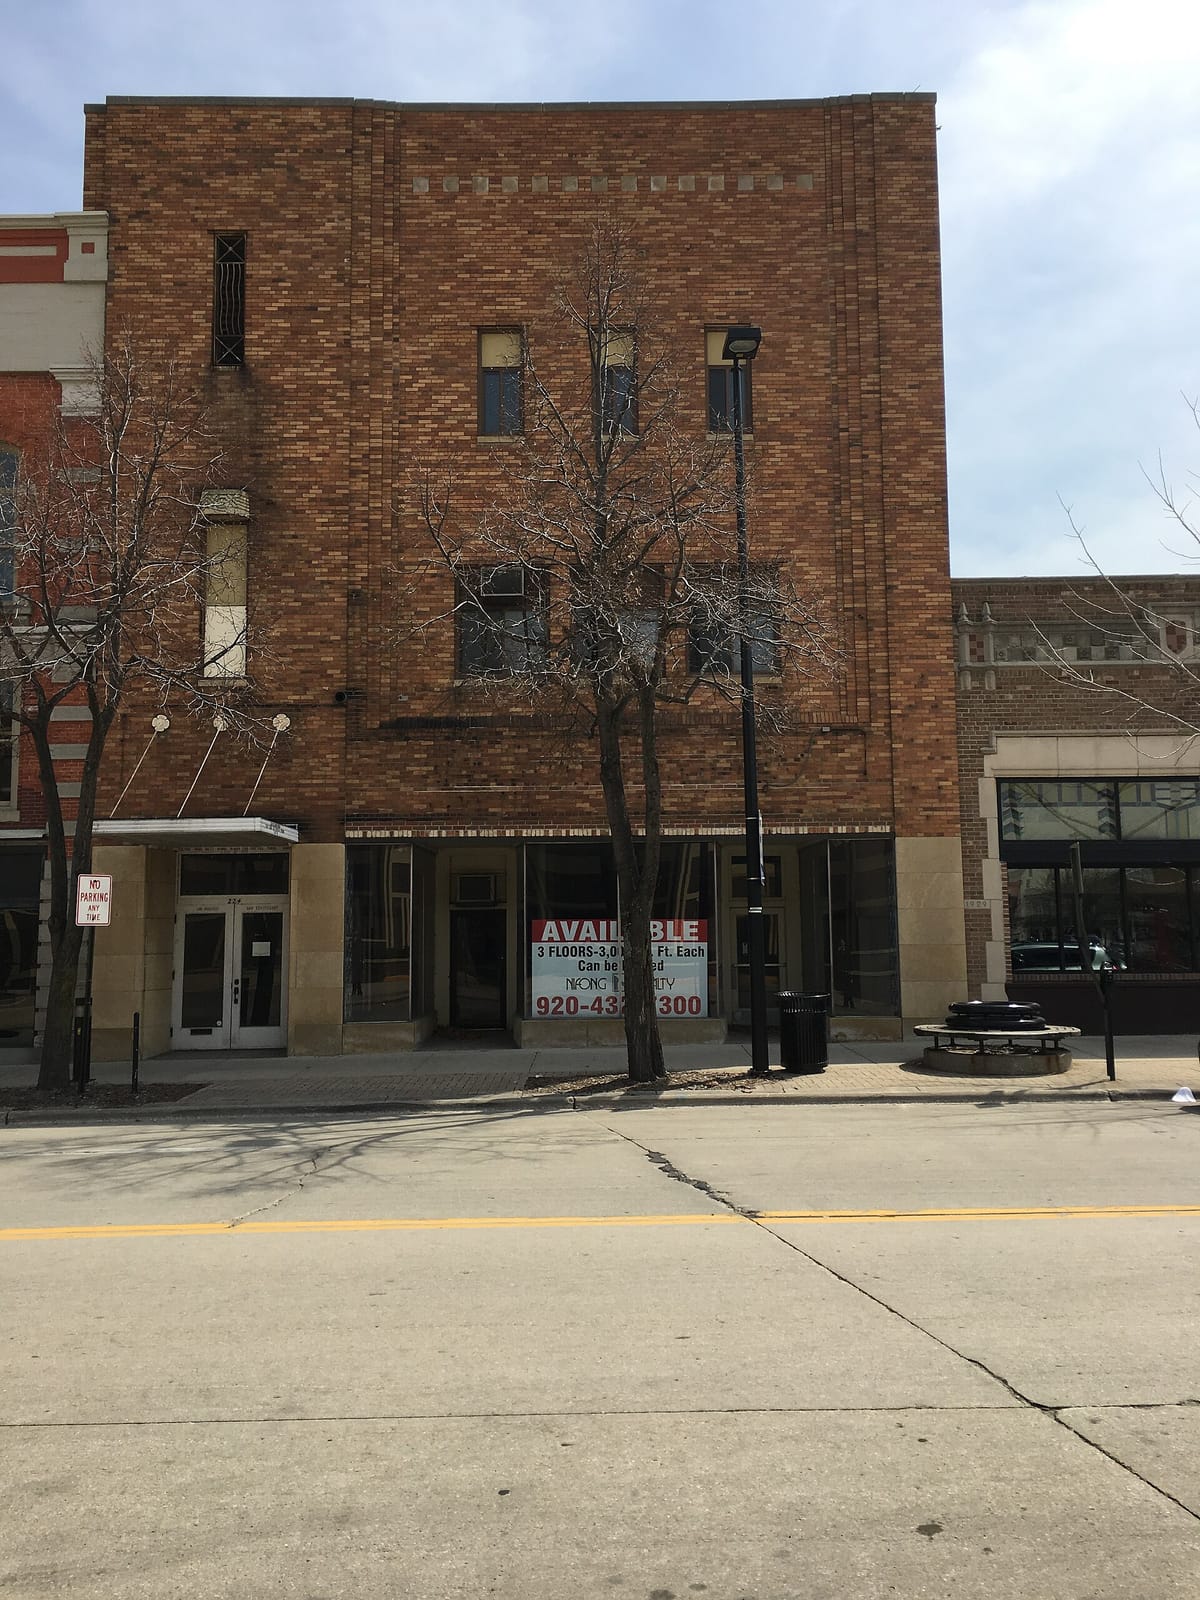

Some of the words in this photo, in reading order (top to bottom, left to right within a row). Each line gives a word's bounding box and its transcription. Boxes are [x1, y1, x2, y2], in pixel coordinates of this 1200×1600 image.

[89, 880, 101, 890] NO
[80, 892, 108, 902] PARKING
[541, 920, 699, 941] AVAILBLE
[538, 946, 545, 958] 3
[657, 946, 673, 958] Ft.
[677, 946, 705, 958] Each
[578, 960, 600, 971] Can
[604, 960, 618, 971] be
[536, 995, 702, 1015] 920-43300
